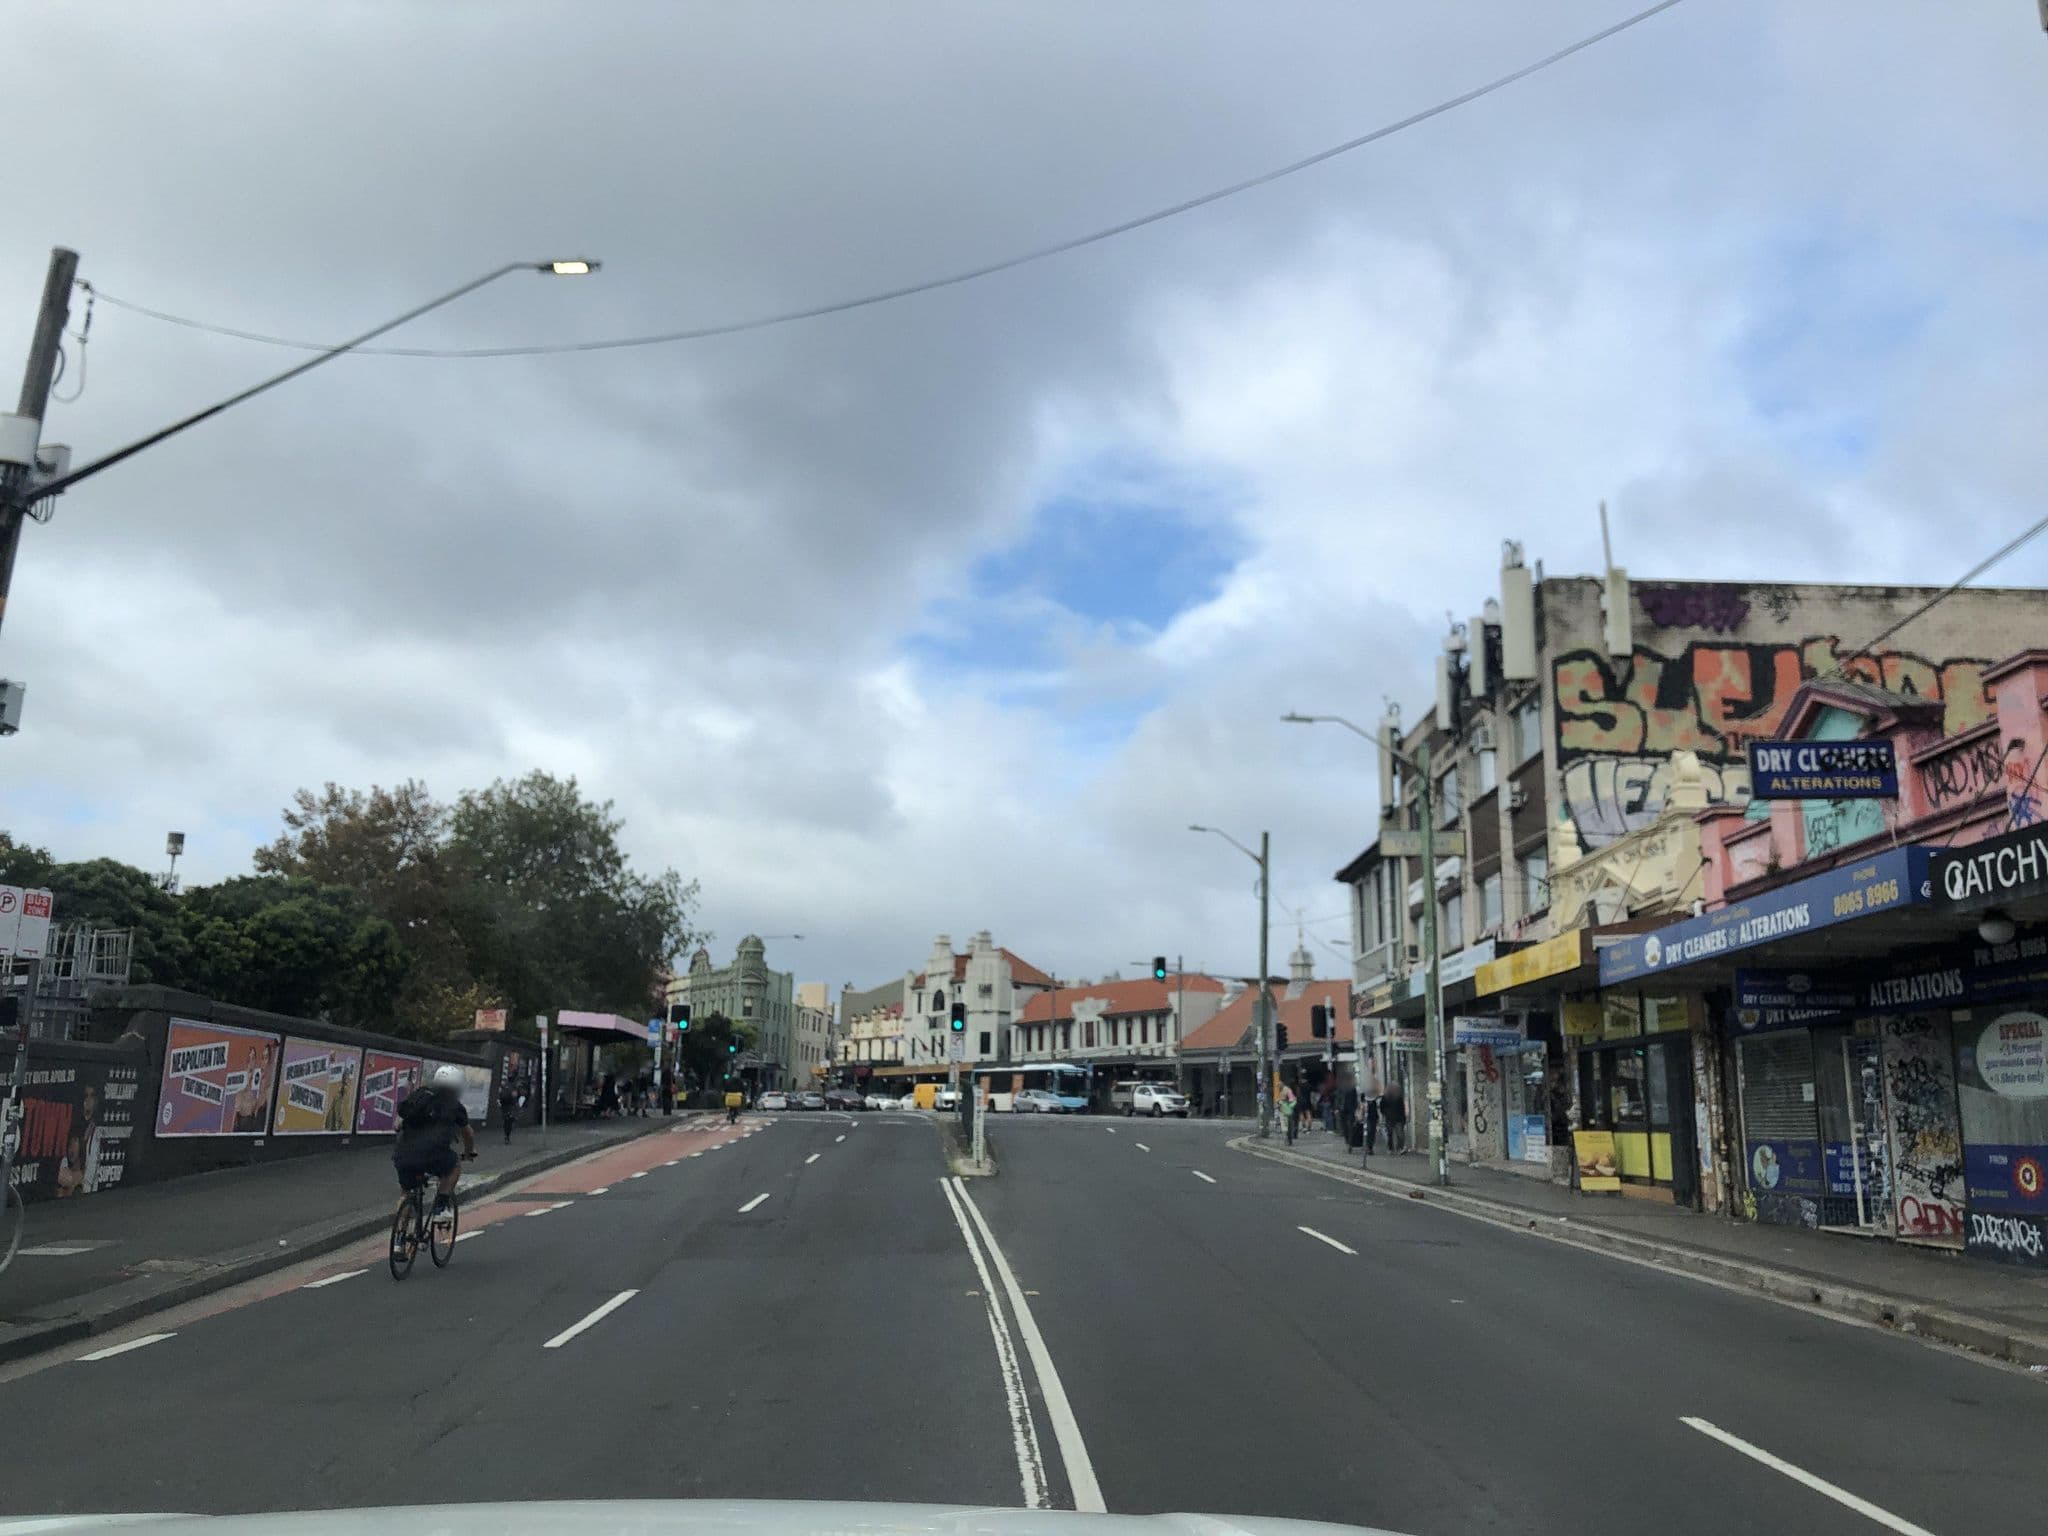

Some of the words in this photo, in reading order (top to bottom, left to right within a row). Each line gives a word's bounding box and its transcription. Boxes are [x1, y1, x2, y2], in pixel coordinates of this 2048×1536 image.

[1757, 748, 1792, 772] DRY
[1771, 776, 1883, 791] ALTERATIONS
[26, 894, 48, 907] BUS
[1665, 943, 1683, 965] DRY
[1684, 927, 1728, 961] CLEANERS
[1739, 903, 1811, 945] ALTERATIONS
[1870, 968, 1964, 1007] ALTERATIONS
[1998, 1020, 2042, 1041] SPECIAL
[21, 1162, 39, 1184] OUT
